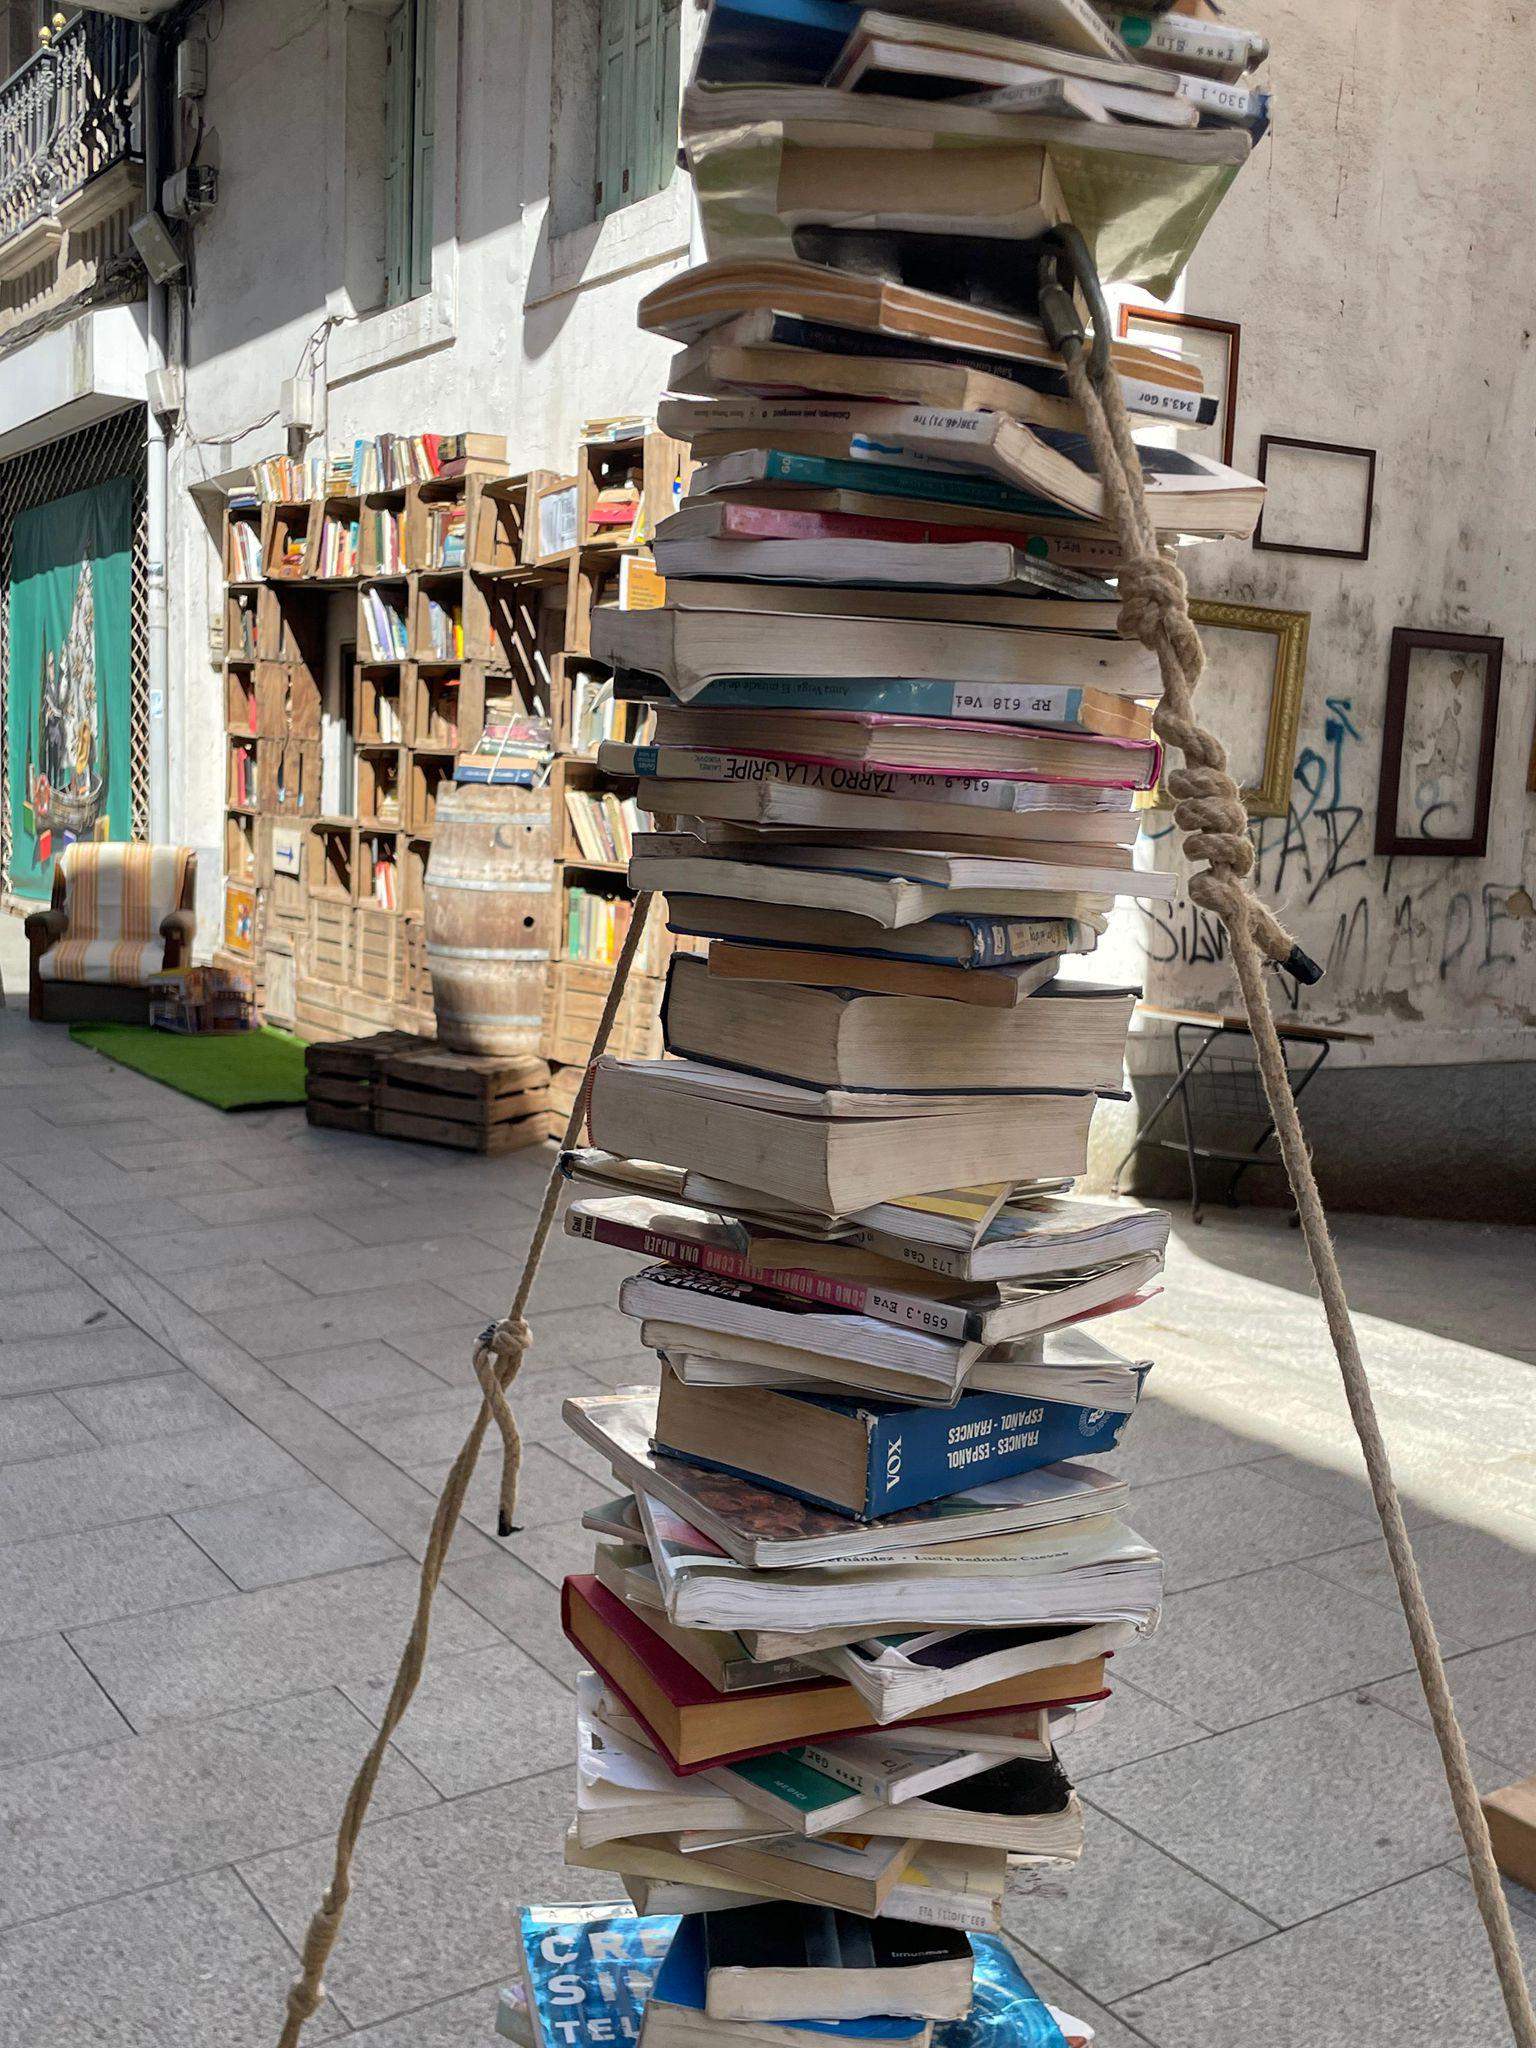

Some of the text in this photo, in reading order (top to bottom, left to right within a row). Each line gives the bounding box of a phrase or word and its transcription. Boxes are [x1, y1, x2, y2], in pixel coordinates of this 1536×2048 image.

[1138, 393, 1194, 412] 343.5 Gor
[955, 695, 1051, 711] RP 618 Vei
[785, 759, 809, 780] LA
[815, 761, 830, 785] Y
[944, 774, 990, 793] 616.9
[642, 1234, 676, 1257] MUJER
[677, 1244, 700, 1263] UNA
[902, 1247, 952, 1274] 173 Cas
[871, 1295, 949, 1330] 658.3 Eva
[948, 1418, 994, 1444] FRANCES
[1000, 1407, 1045, 1431] ESPAÑOL
[997, 1430, 1039, 1455] FRANCES
[886, 1436, 903, 1492] VOX
[947, 1442, 991, 1469] ESPAÑOL
